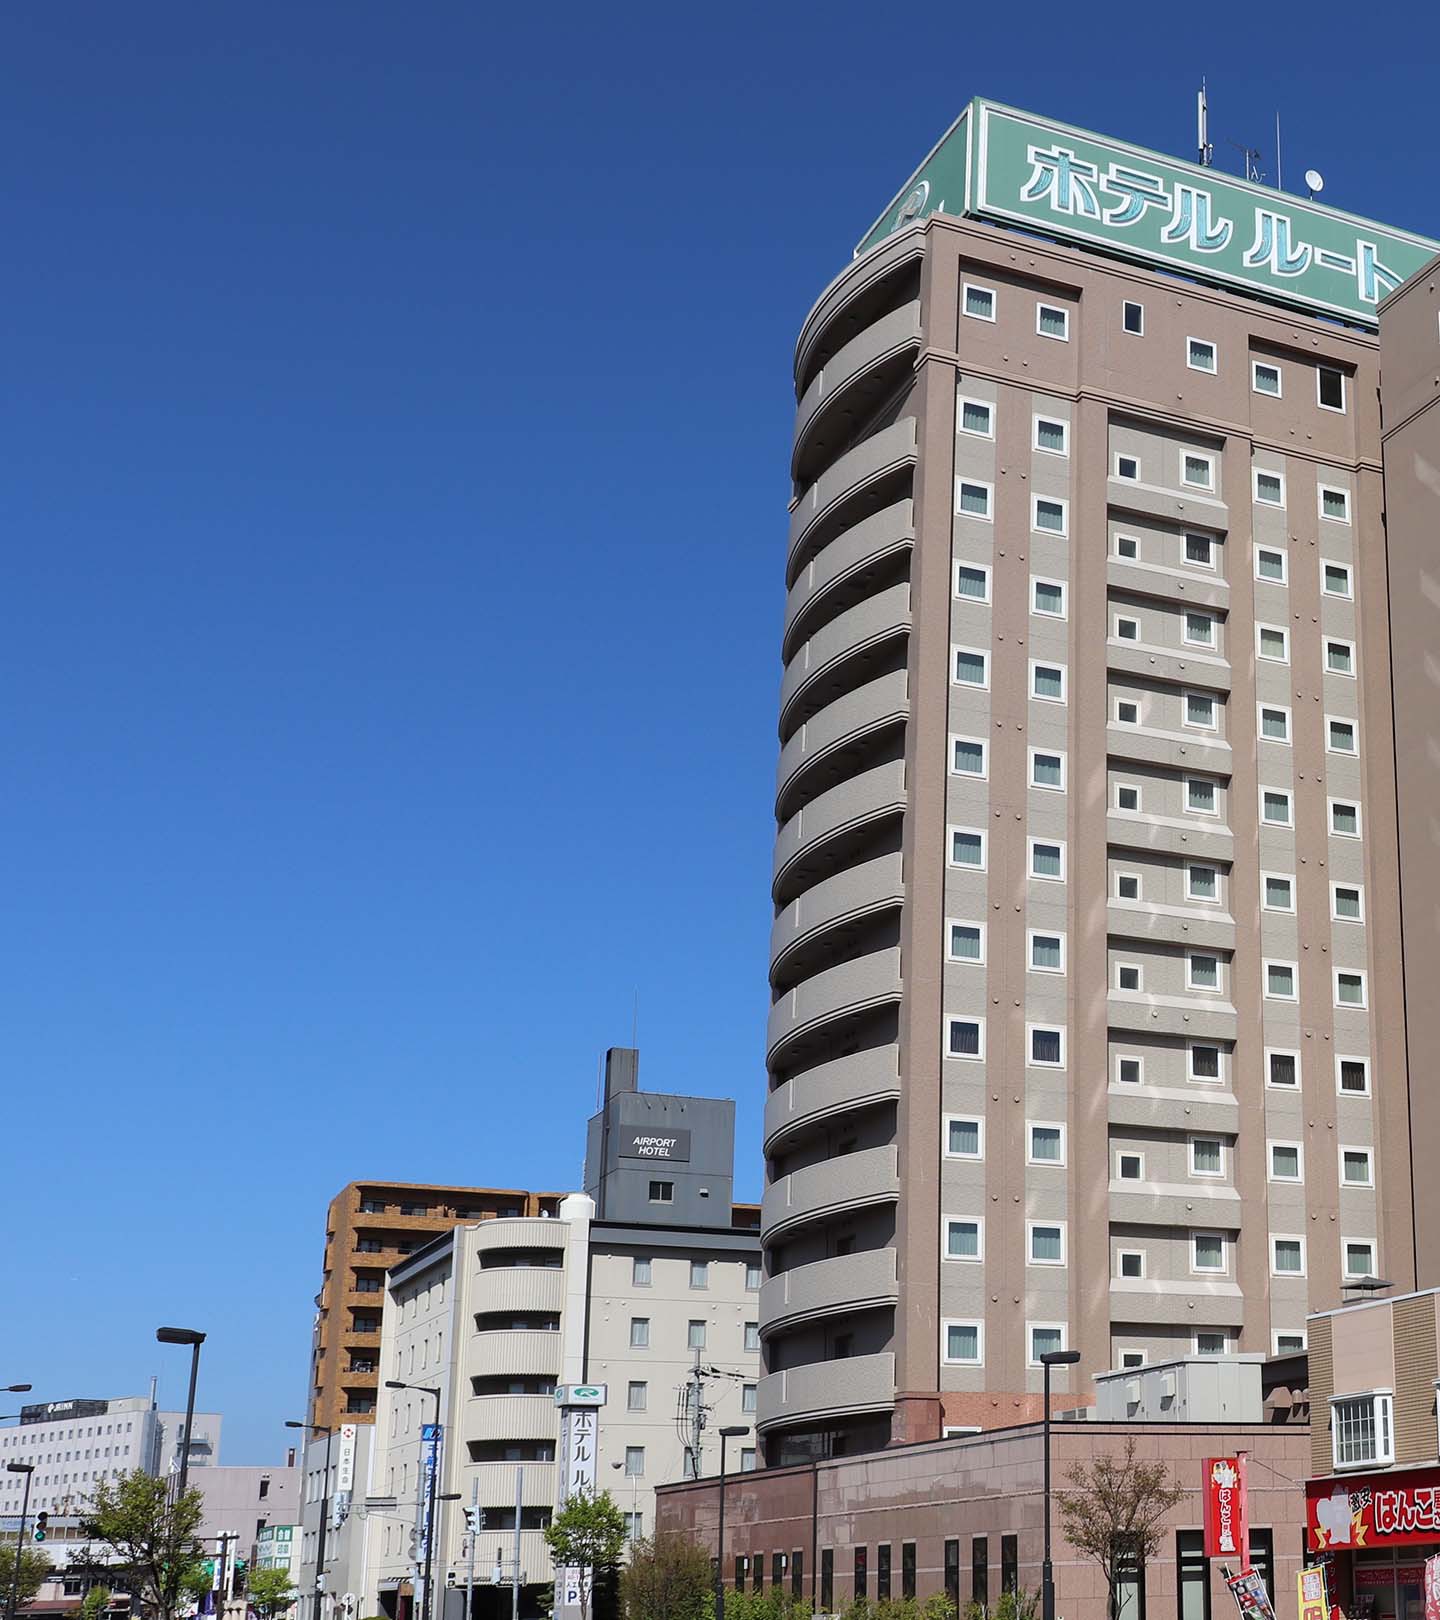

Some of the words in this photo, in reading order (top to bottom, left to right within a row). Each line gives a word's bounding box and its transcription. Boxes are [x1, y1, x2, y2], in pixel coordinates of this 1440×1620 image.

[1020, 144, 1232, 253] ホテル
[633, 1137, 677, 1147] AIRPORT
[638, 1147, 670, 1156] HOTEL
[573, 1411, 592, 1462] ホテル
[568, 1591, 577, 1603] P
